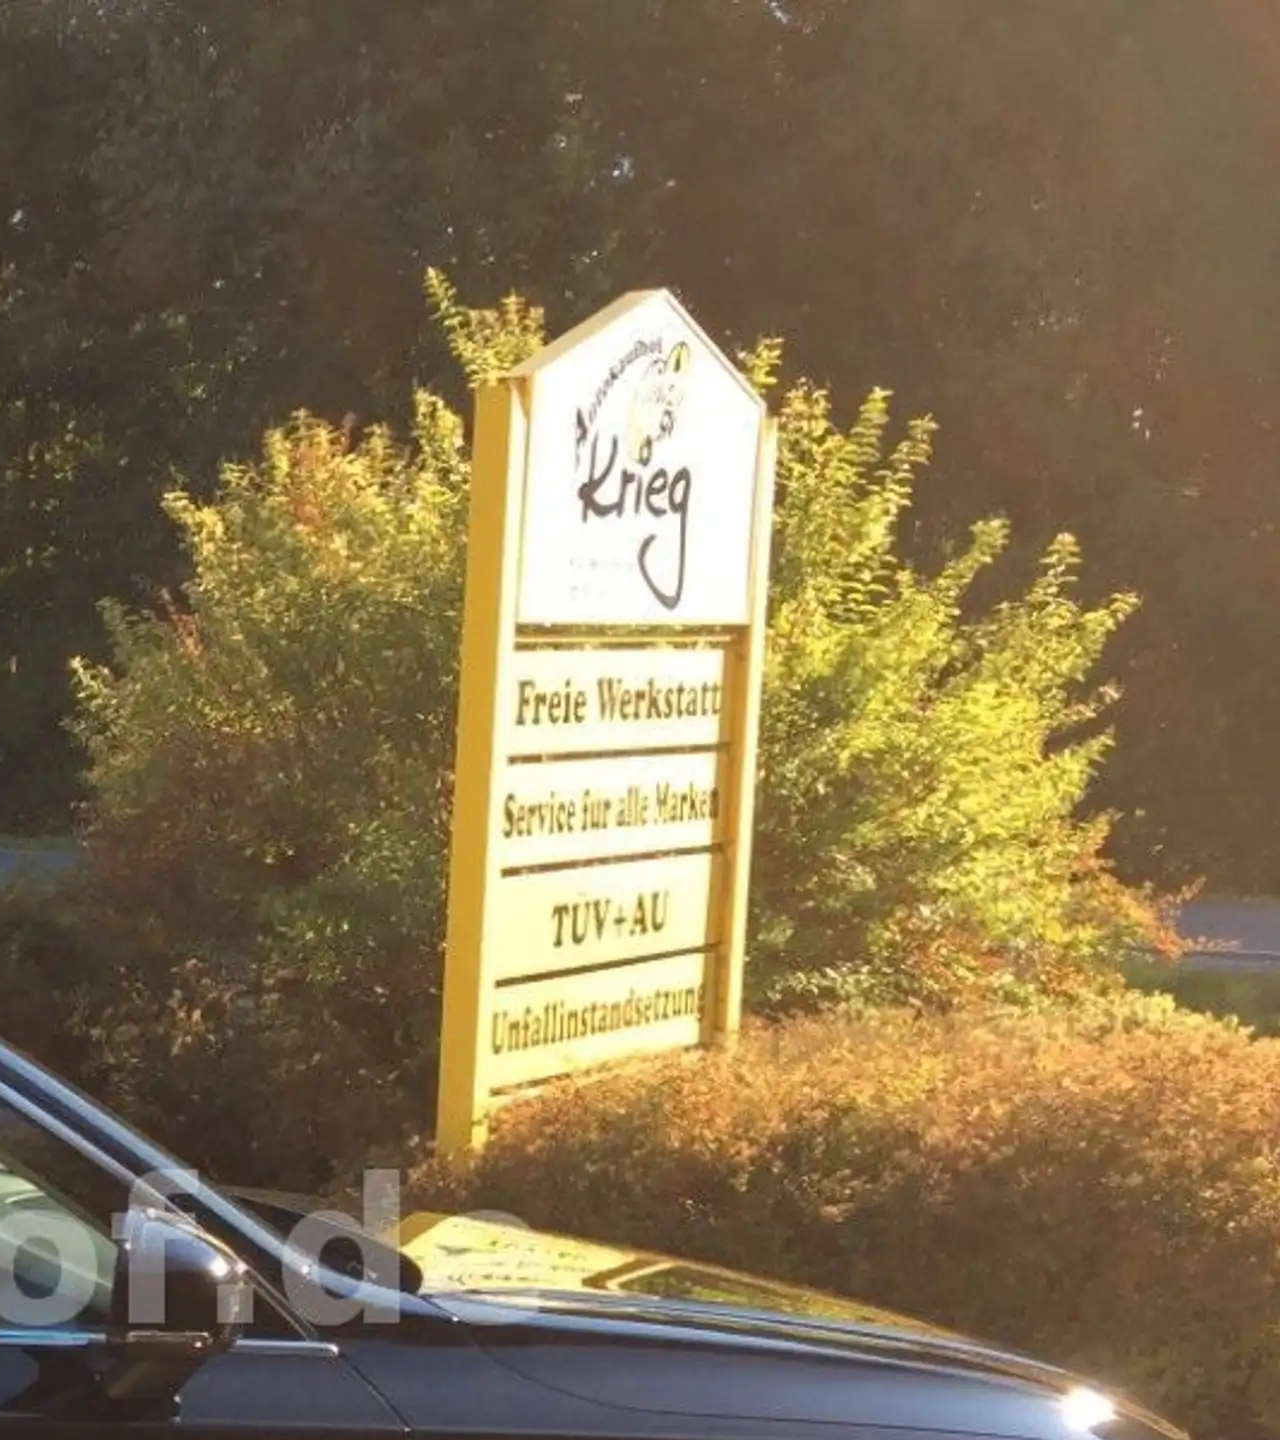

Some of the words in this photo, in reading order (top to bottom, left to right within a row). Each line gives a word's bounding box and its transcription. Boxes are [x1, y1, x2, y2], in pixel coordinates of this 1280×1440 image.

[577, 433, 692, 612] Krieg
[515, 678, 587, 728] Freie
[597, 676, 722, 720] Werkstatt
[502, 792, 576, 839] Service
[615, 786, 649, 827] alle
